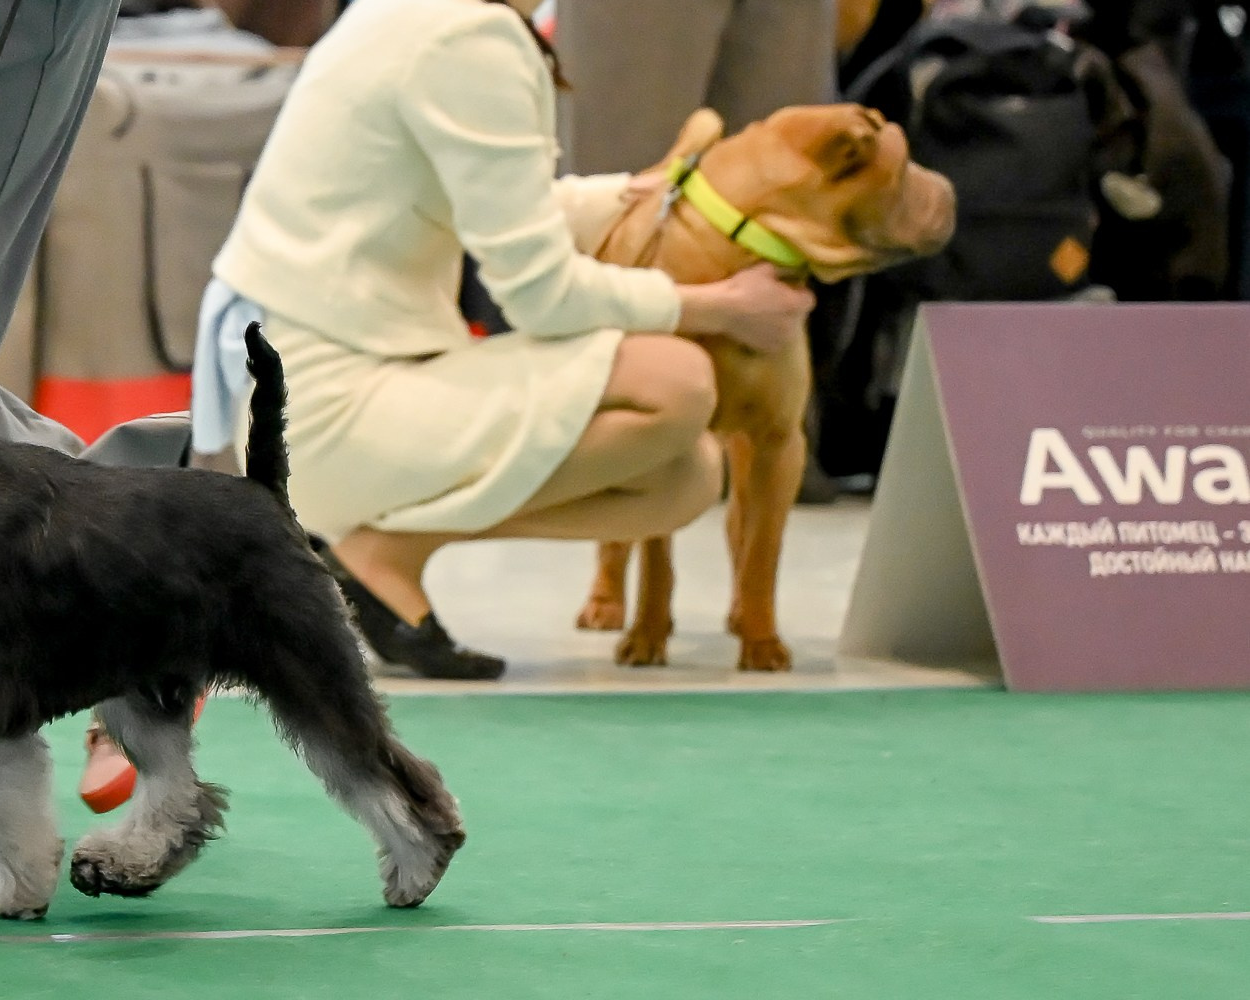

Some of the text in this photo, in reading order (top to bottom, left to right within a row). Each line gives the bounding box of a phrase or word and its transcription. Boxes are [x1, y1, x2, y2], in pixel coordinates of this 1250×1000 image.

[1016, 516, 1116, 548] КАЖДЫЙ
[1117, 519, 1220, 548] ПИТОМЕЦ
[1089, 545, 1217, 577] ДОСТОЙНЫЙ
